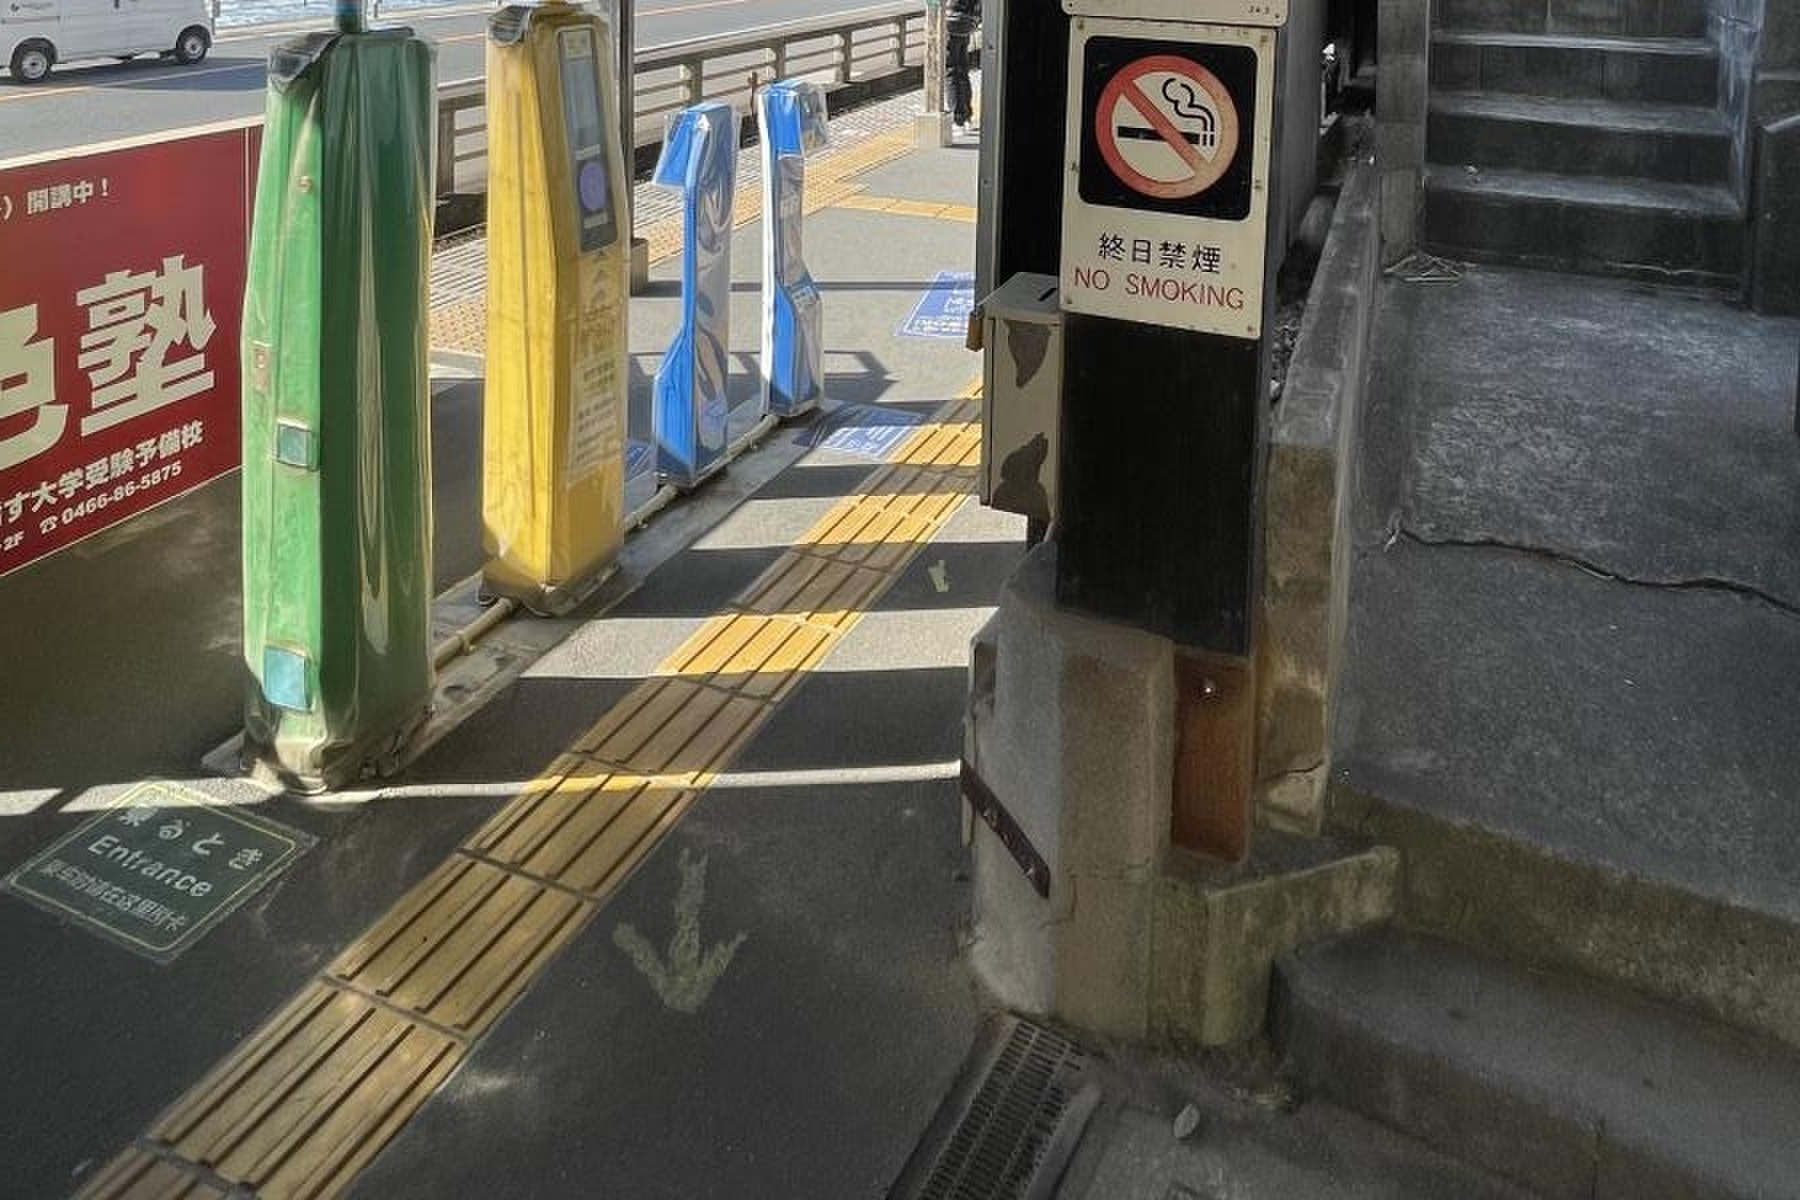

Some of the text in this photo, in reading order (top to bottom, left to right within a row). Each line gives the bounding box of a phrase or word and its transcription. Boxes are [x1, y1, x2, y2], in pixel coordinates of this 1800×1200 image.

[1098, 232, 1222, 275] 終日禁煙
[1074, 266, 1245, 310] NO SMOKING
[0, 419, 204, 526] す大学受験予備校
[60, 459, 183, 525] 0466-86-5875
[87, 834, 214, 897] Entrance
